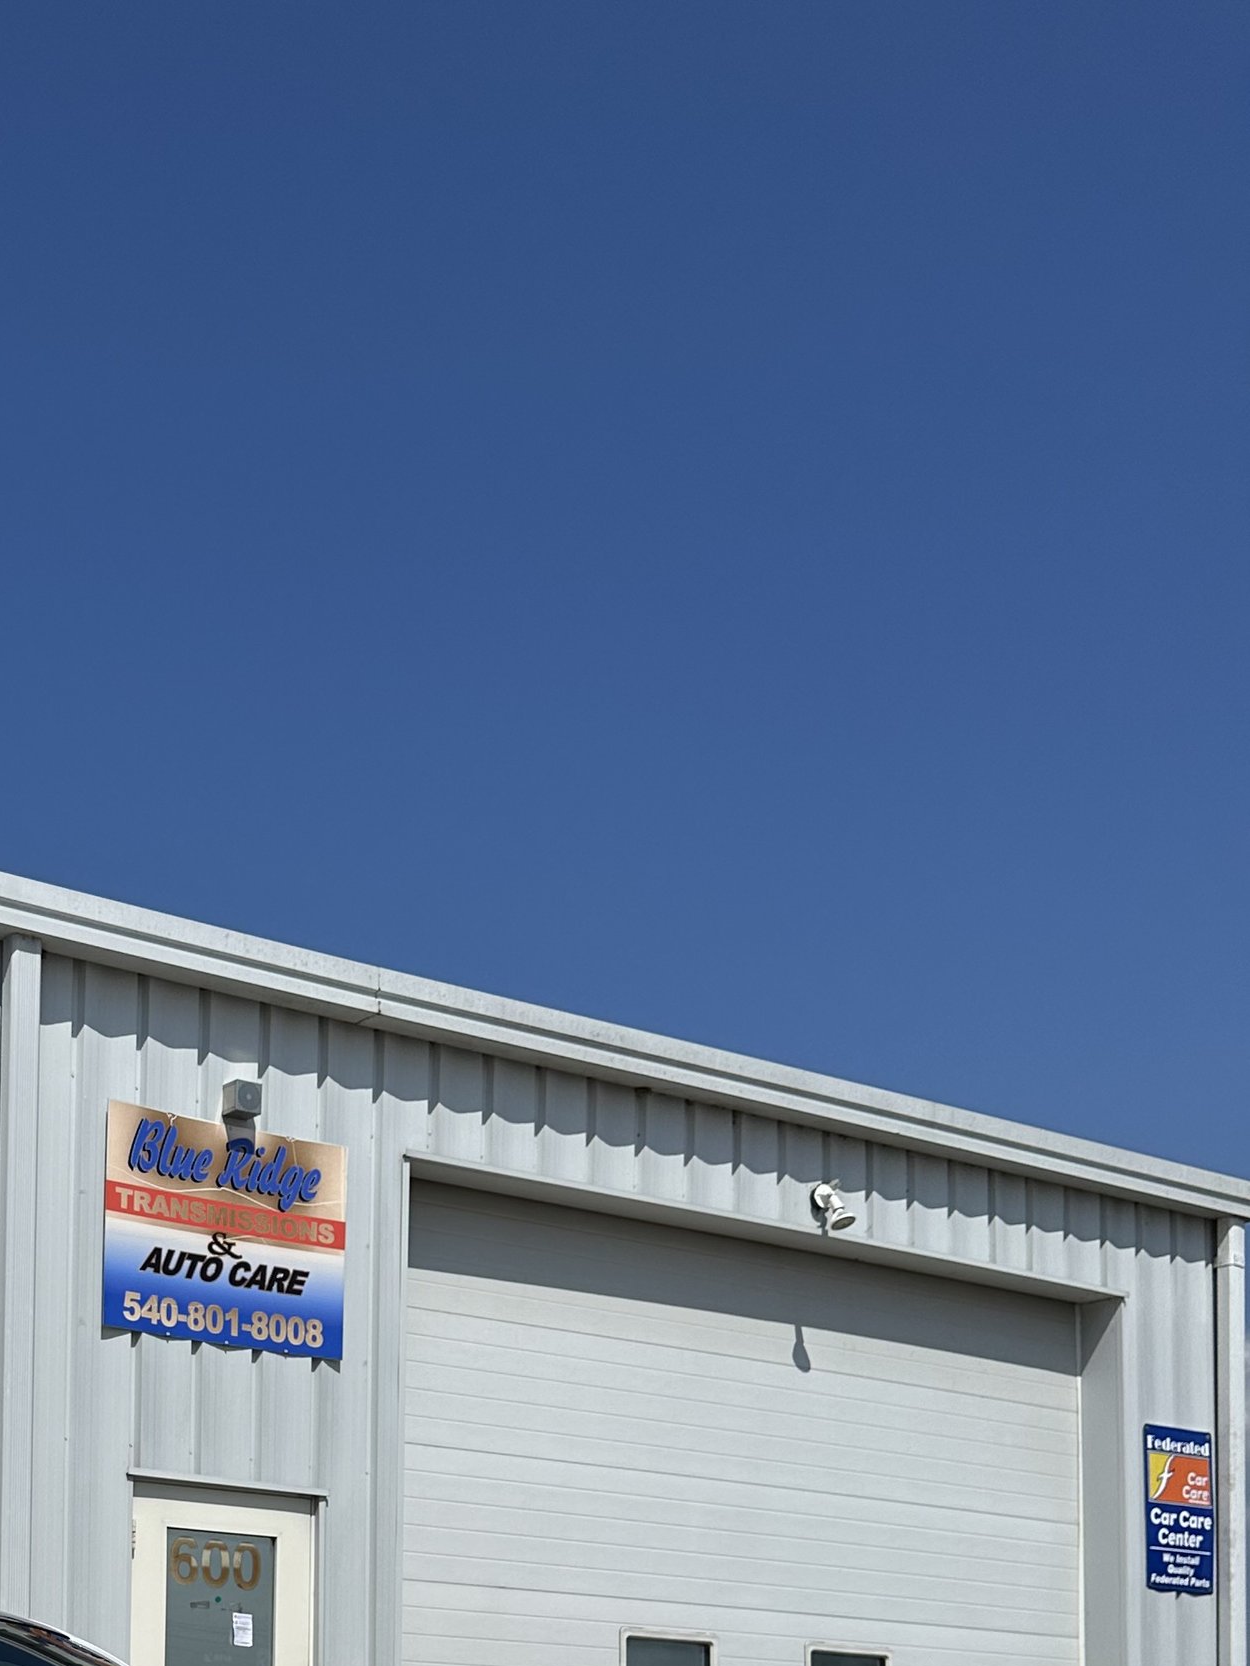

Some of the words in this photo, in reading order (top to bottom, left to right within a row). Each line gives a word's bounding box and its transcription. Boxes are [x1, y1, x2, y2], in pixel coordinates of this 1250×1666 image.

[128, 1118, 214, 1184] Blue
[216, 1140, 322, 1212] Ridge
[115, 1186, 335, 1244] TRANSMISSIONS
[207, 1231, 243, 1259] &
[140, 1247, 223, 1283] AUTO
[228, 1260, 309, 1296] CARE
[122, 1290, 324, 1348] 540-801-8008
[1146, 1434, 1210, 1457] Federated
[1187, 1472, 1209, 1487] Car
[1182, 1485, 1210, 1501] Care
[1150, 1507, 1178, 1526] Car
[1178, 1511, 1213, 1531] Care
[1158, 1527, 1204, 1549] Center
[170, 1536, 261, 1591] 600
[1162, 1552, 1175, 1563] We
[1150, 1572, 1189, 1587] Federated
[1189, 1576, 1211, 1589] Parts
[1167, 1563, 1195, 1577] Quality
